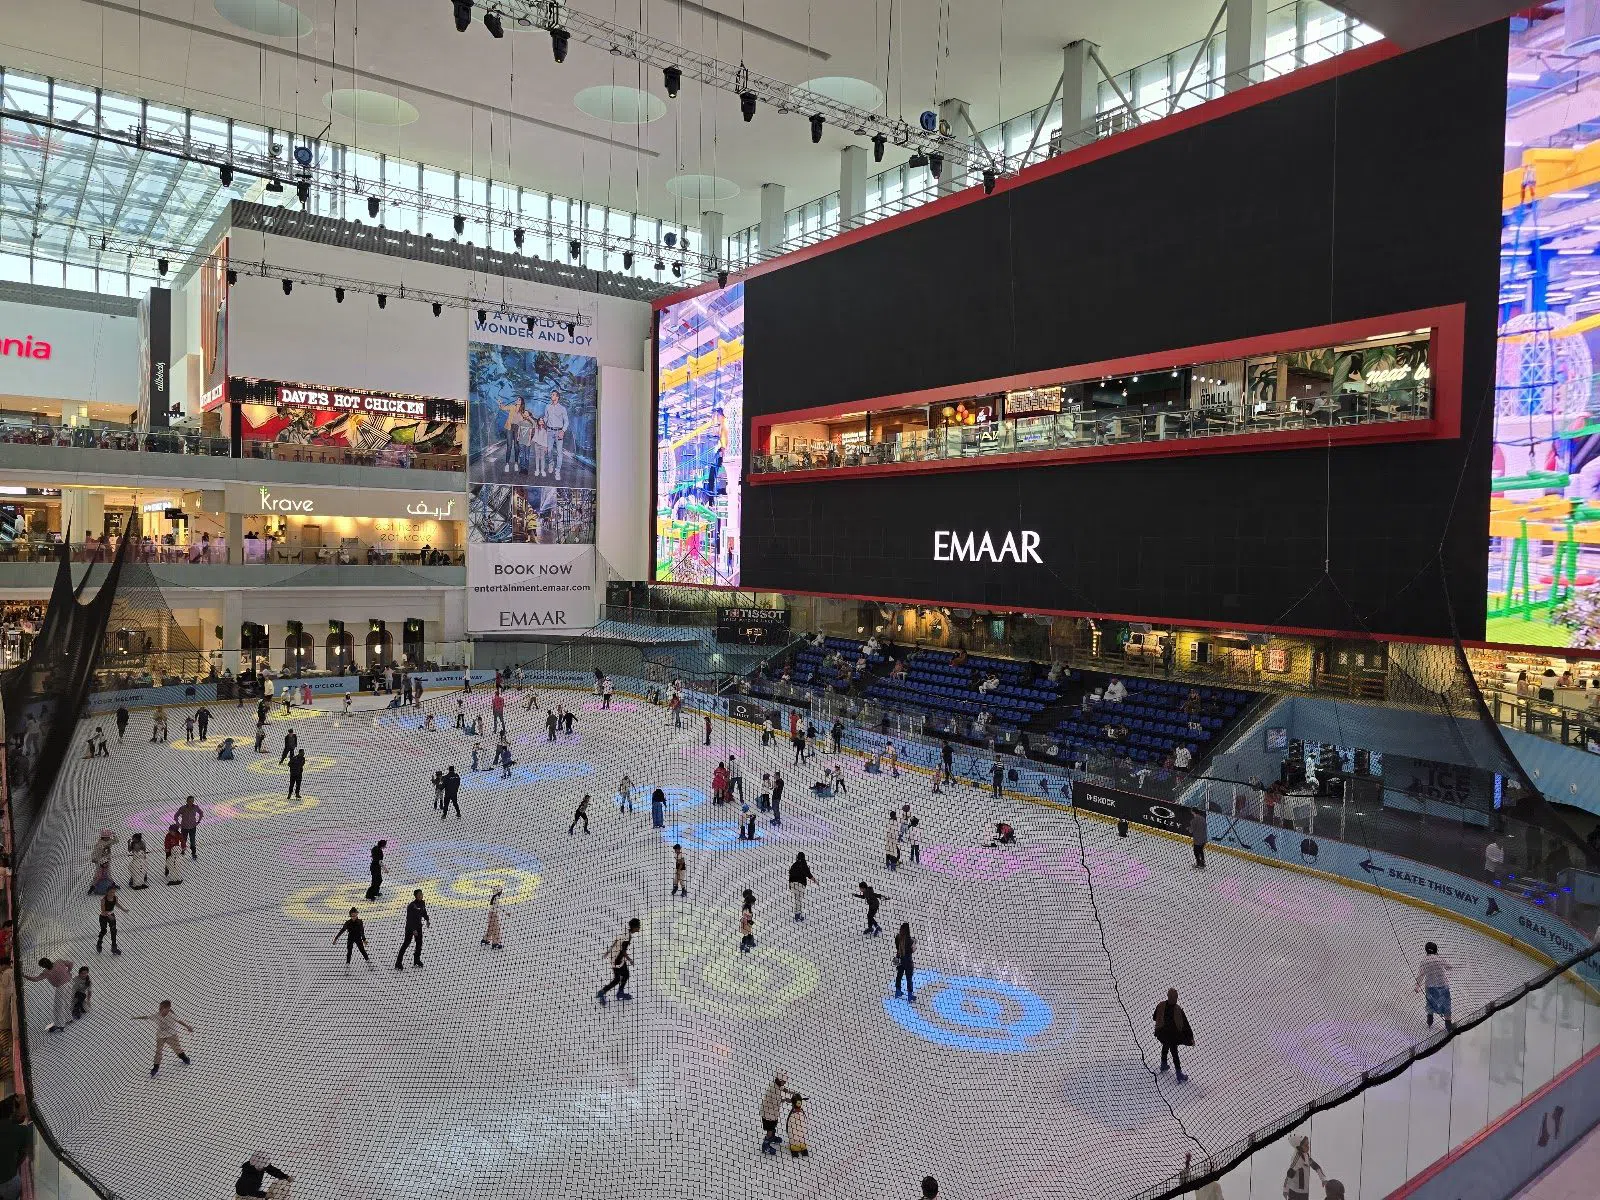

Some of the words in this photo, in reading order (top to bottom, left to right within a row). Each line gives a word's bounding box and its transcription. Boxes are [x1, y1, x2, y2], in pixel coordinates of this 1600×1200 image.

[474, 321, 534, 339] WONDER
[538, 331, 565, 343] AND
[569, 335, 593, 346] JOY
[154, 362, 166, 391] allbirds
[281, 389, 329, 406] DAVE'S
[334, 394, 360, 409] HOT
[364, 398, 425, 414] CHICKEN
[260, 488, 314, 512] Krave
[934, 531, 1043, 563] EMAAR
[494, 564, 535, 575] BOOK
[539, 564, 573, 575] NOW
[474, 584, 591, 593] entertainment.emaar.com
[499, 610, 567, 627] EMAAR
[739, 609, 785, 620] TISSOT
[1388, 868, 1426, 887] SKATE
[1427, 879, 1453, 896] THIS
[1454, 888, 1480, 905] WAY
[1518, 915, 1547, 937] GRAB
[1548, 930, 1574, 953] YOUR
